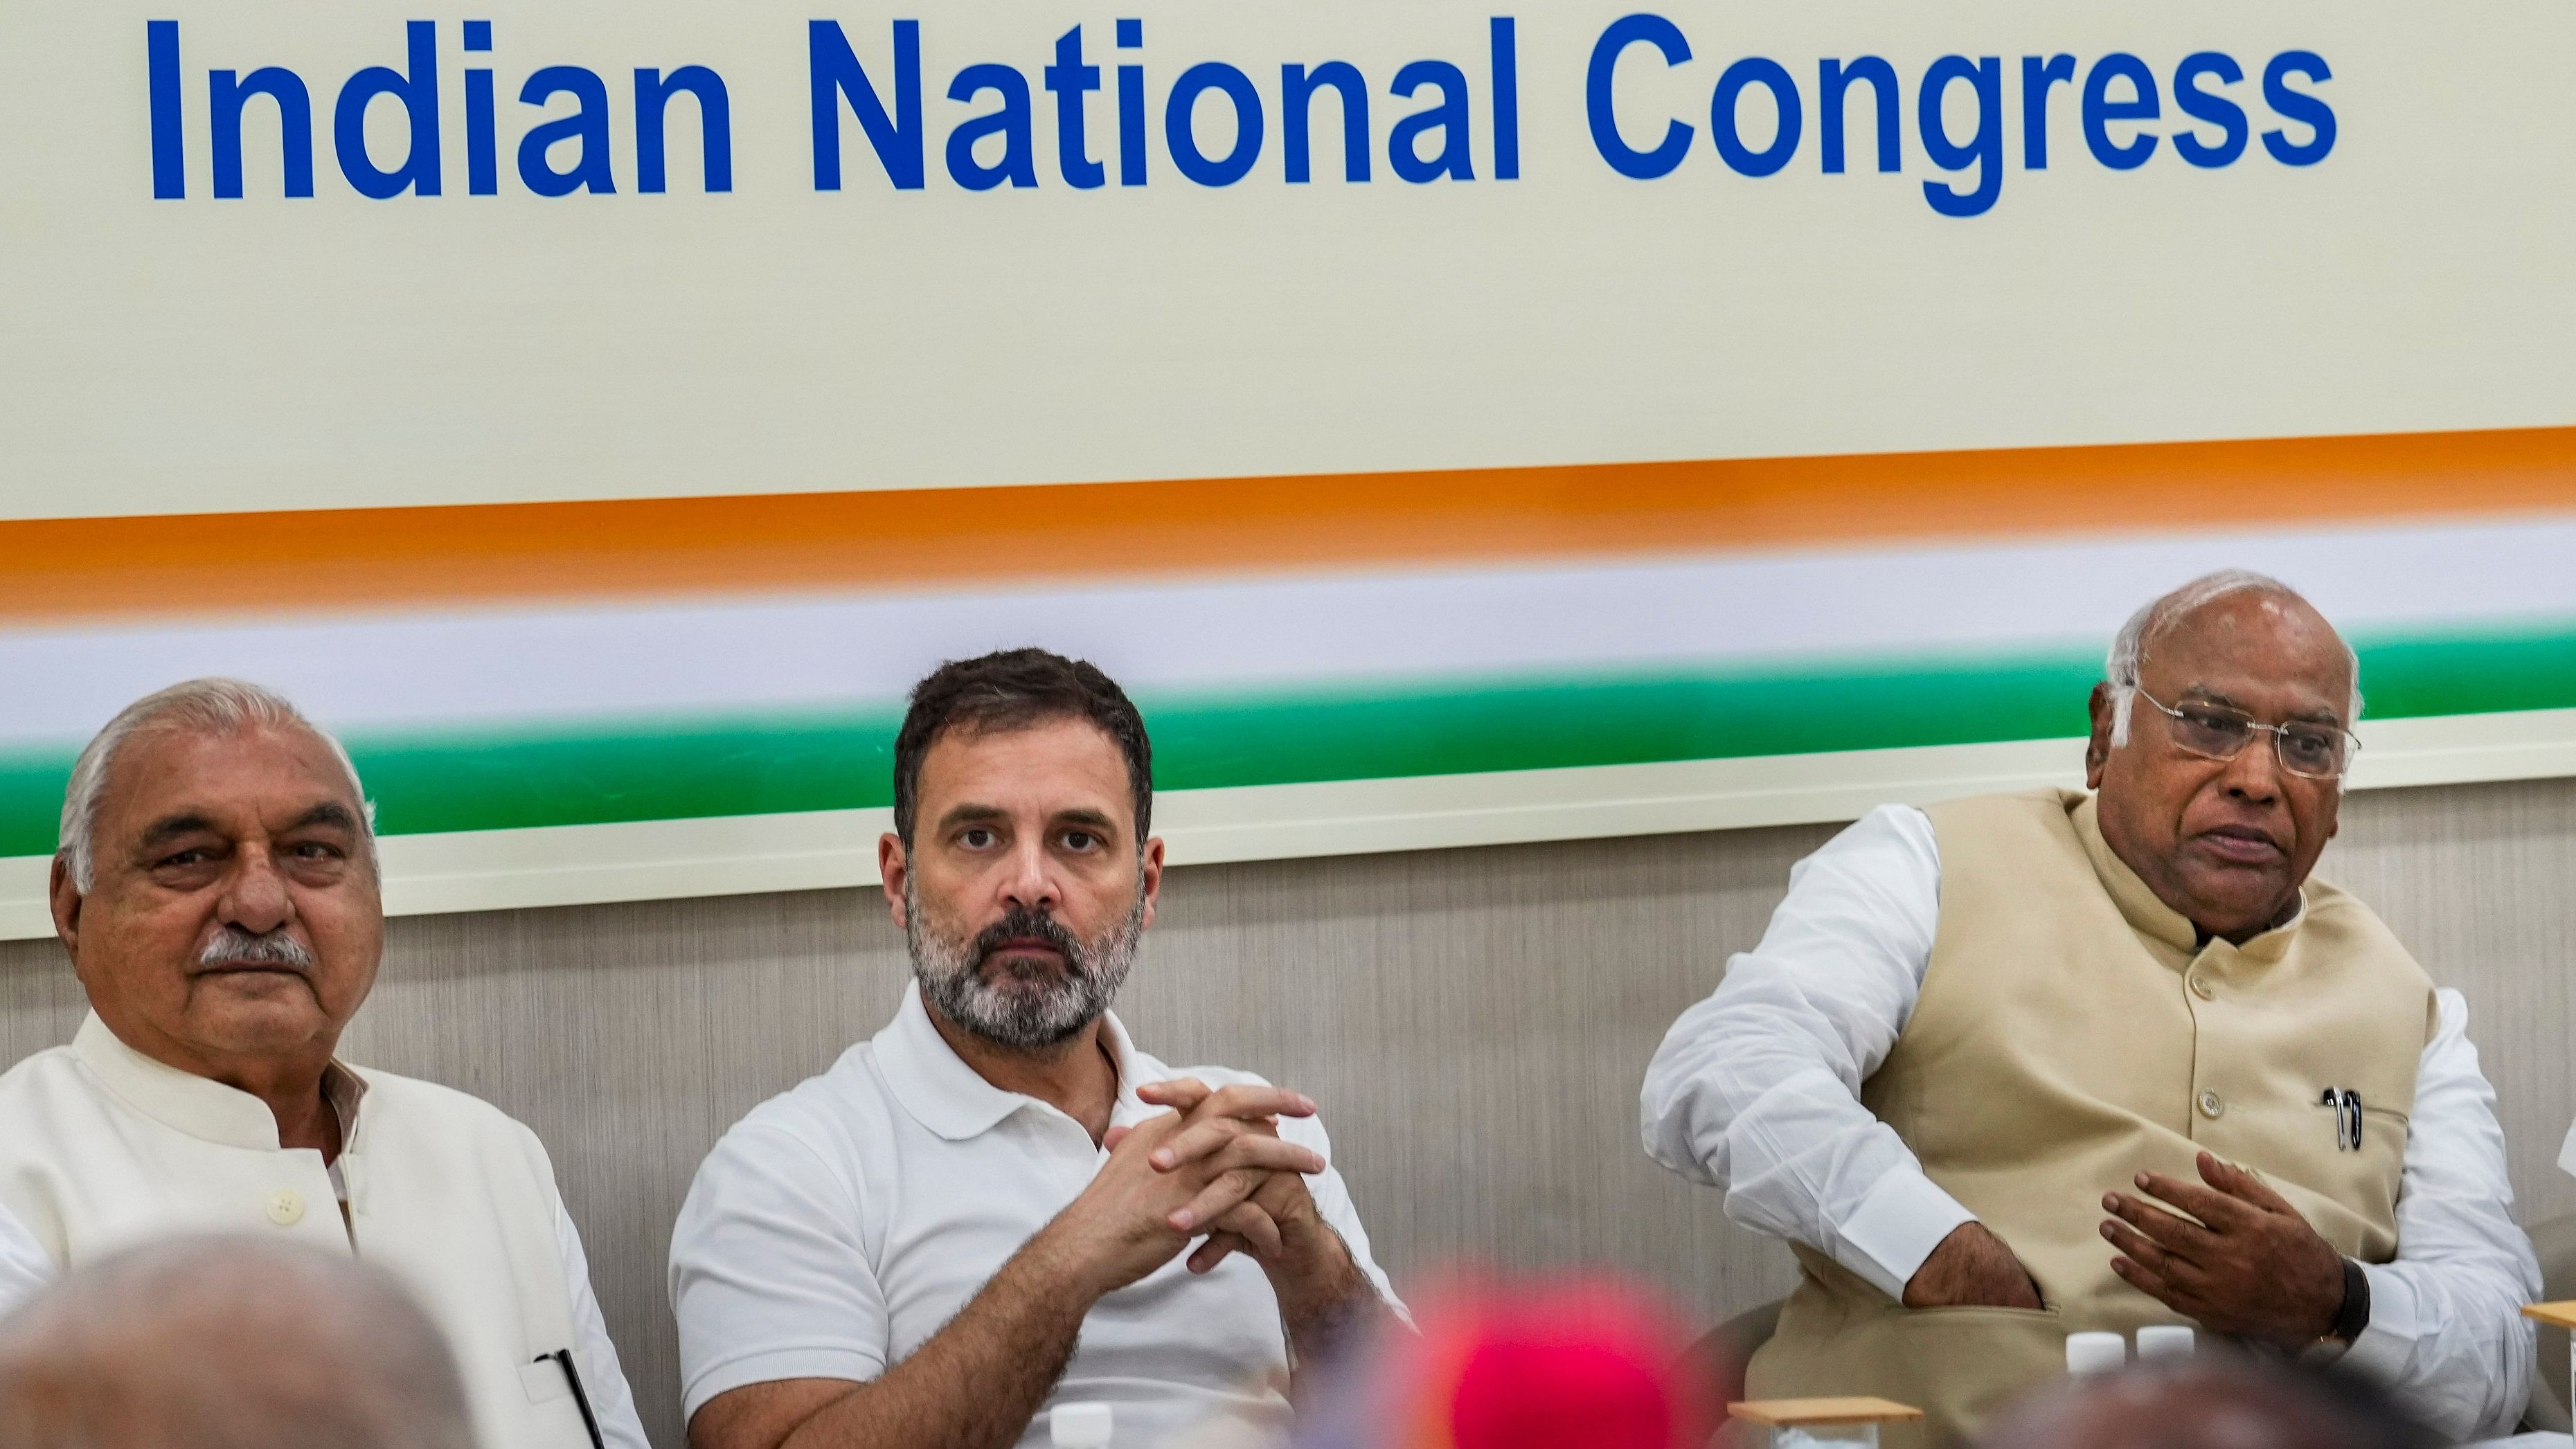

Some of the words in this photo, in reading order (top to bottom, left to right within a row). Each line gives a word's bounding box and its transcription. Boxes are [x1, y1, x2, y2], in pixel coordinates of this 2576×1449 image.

[147, 19, 733, 200] Indian
[809, 17, 1519, 192] National
[1586, 12, 2338, 219] Congress
